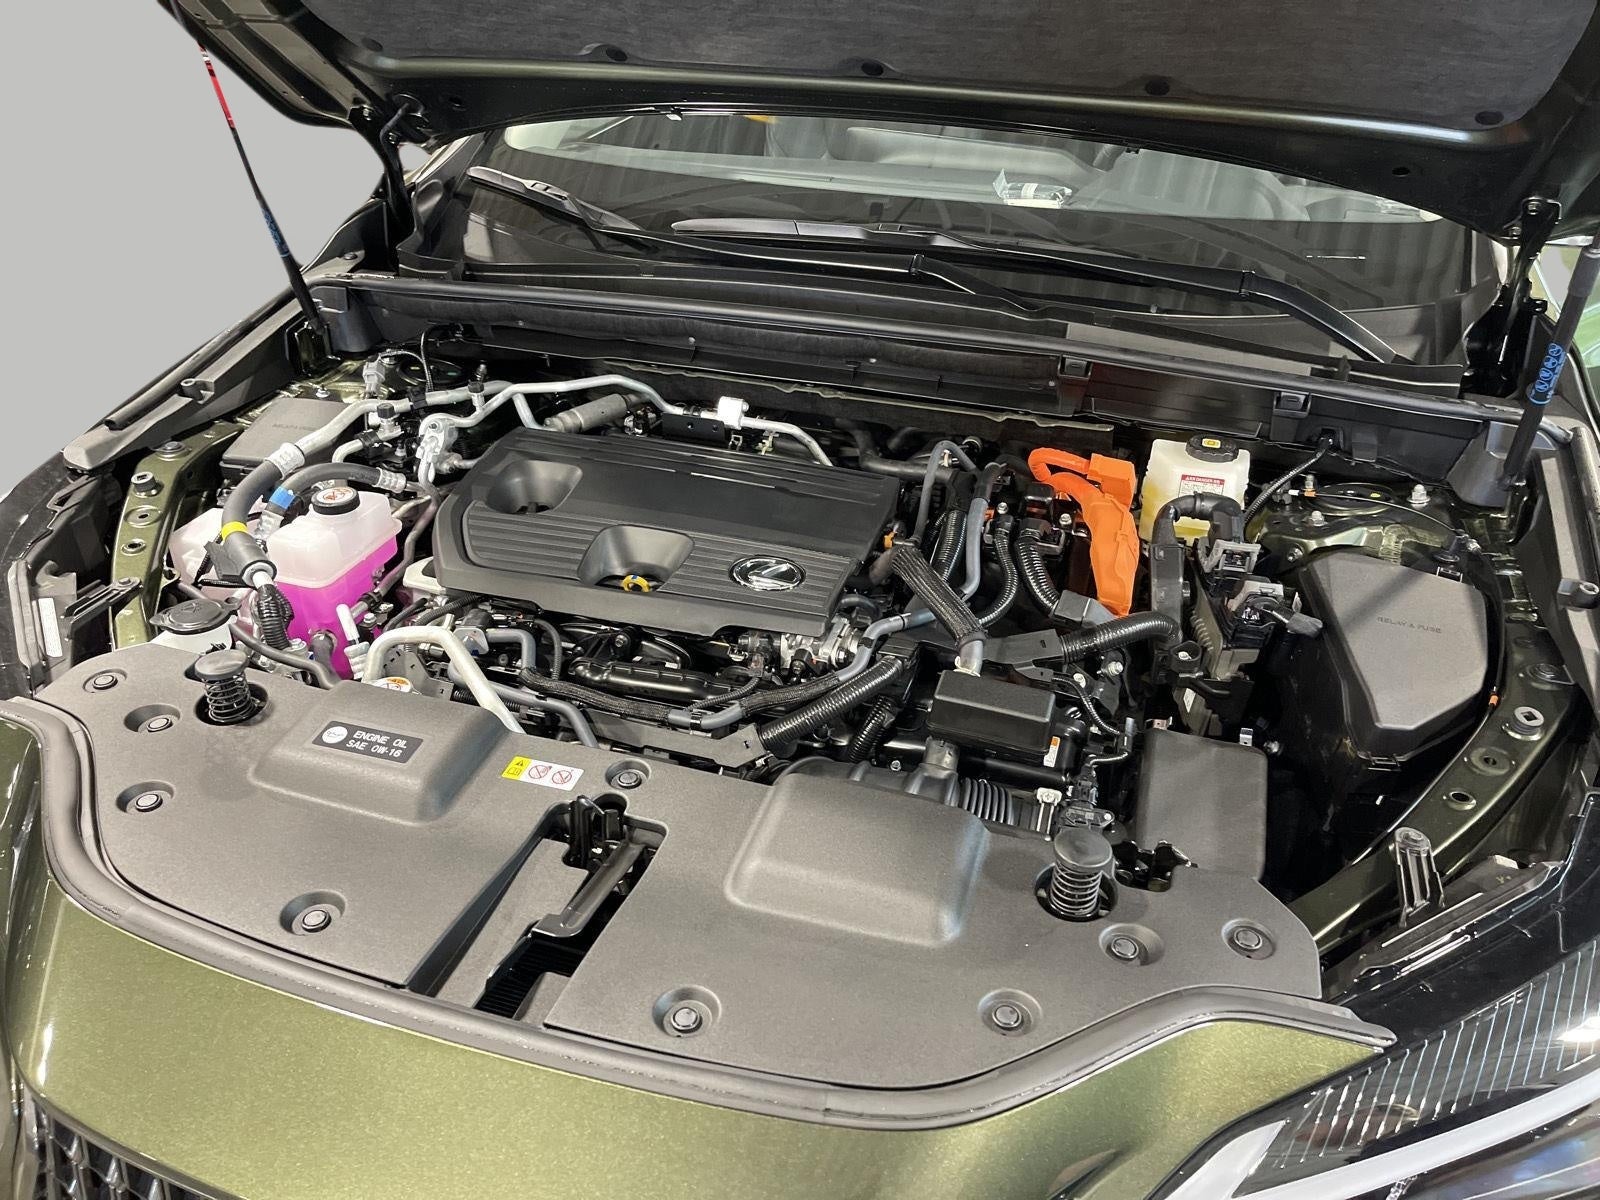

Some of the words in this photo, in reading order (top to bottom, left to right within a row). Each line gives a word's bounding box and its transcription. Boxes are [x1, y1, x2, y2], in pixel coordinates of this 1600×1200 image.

[1377, 616, 1407, 626] RELAY
[1418, 624, 1442, 634] FUSE
[346, 740, 368, 750] SAE
[371, 745, 402, 757] 0W-16
[353, 731, 390, 744] ENGINE
[393, 739, 407, 749] OIL
